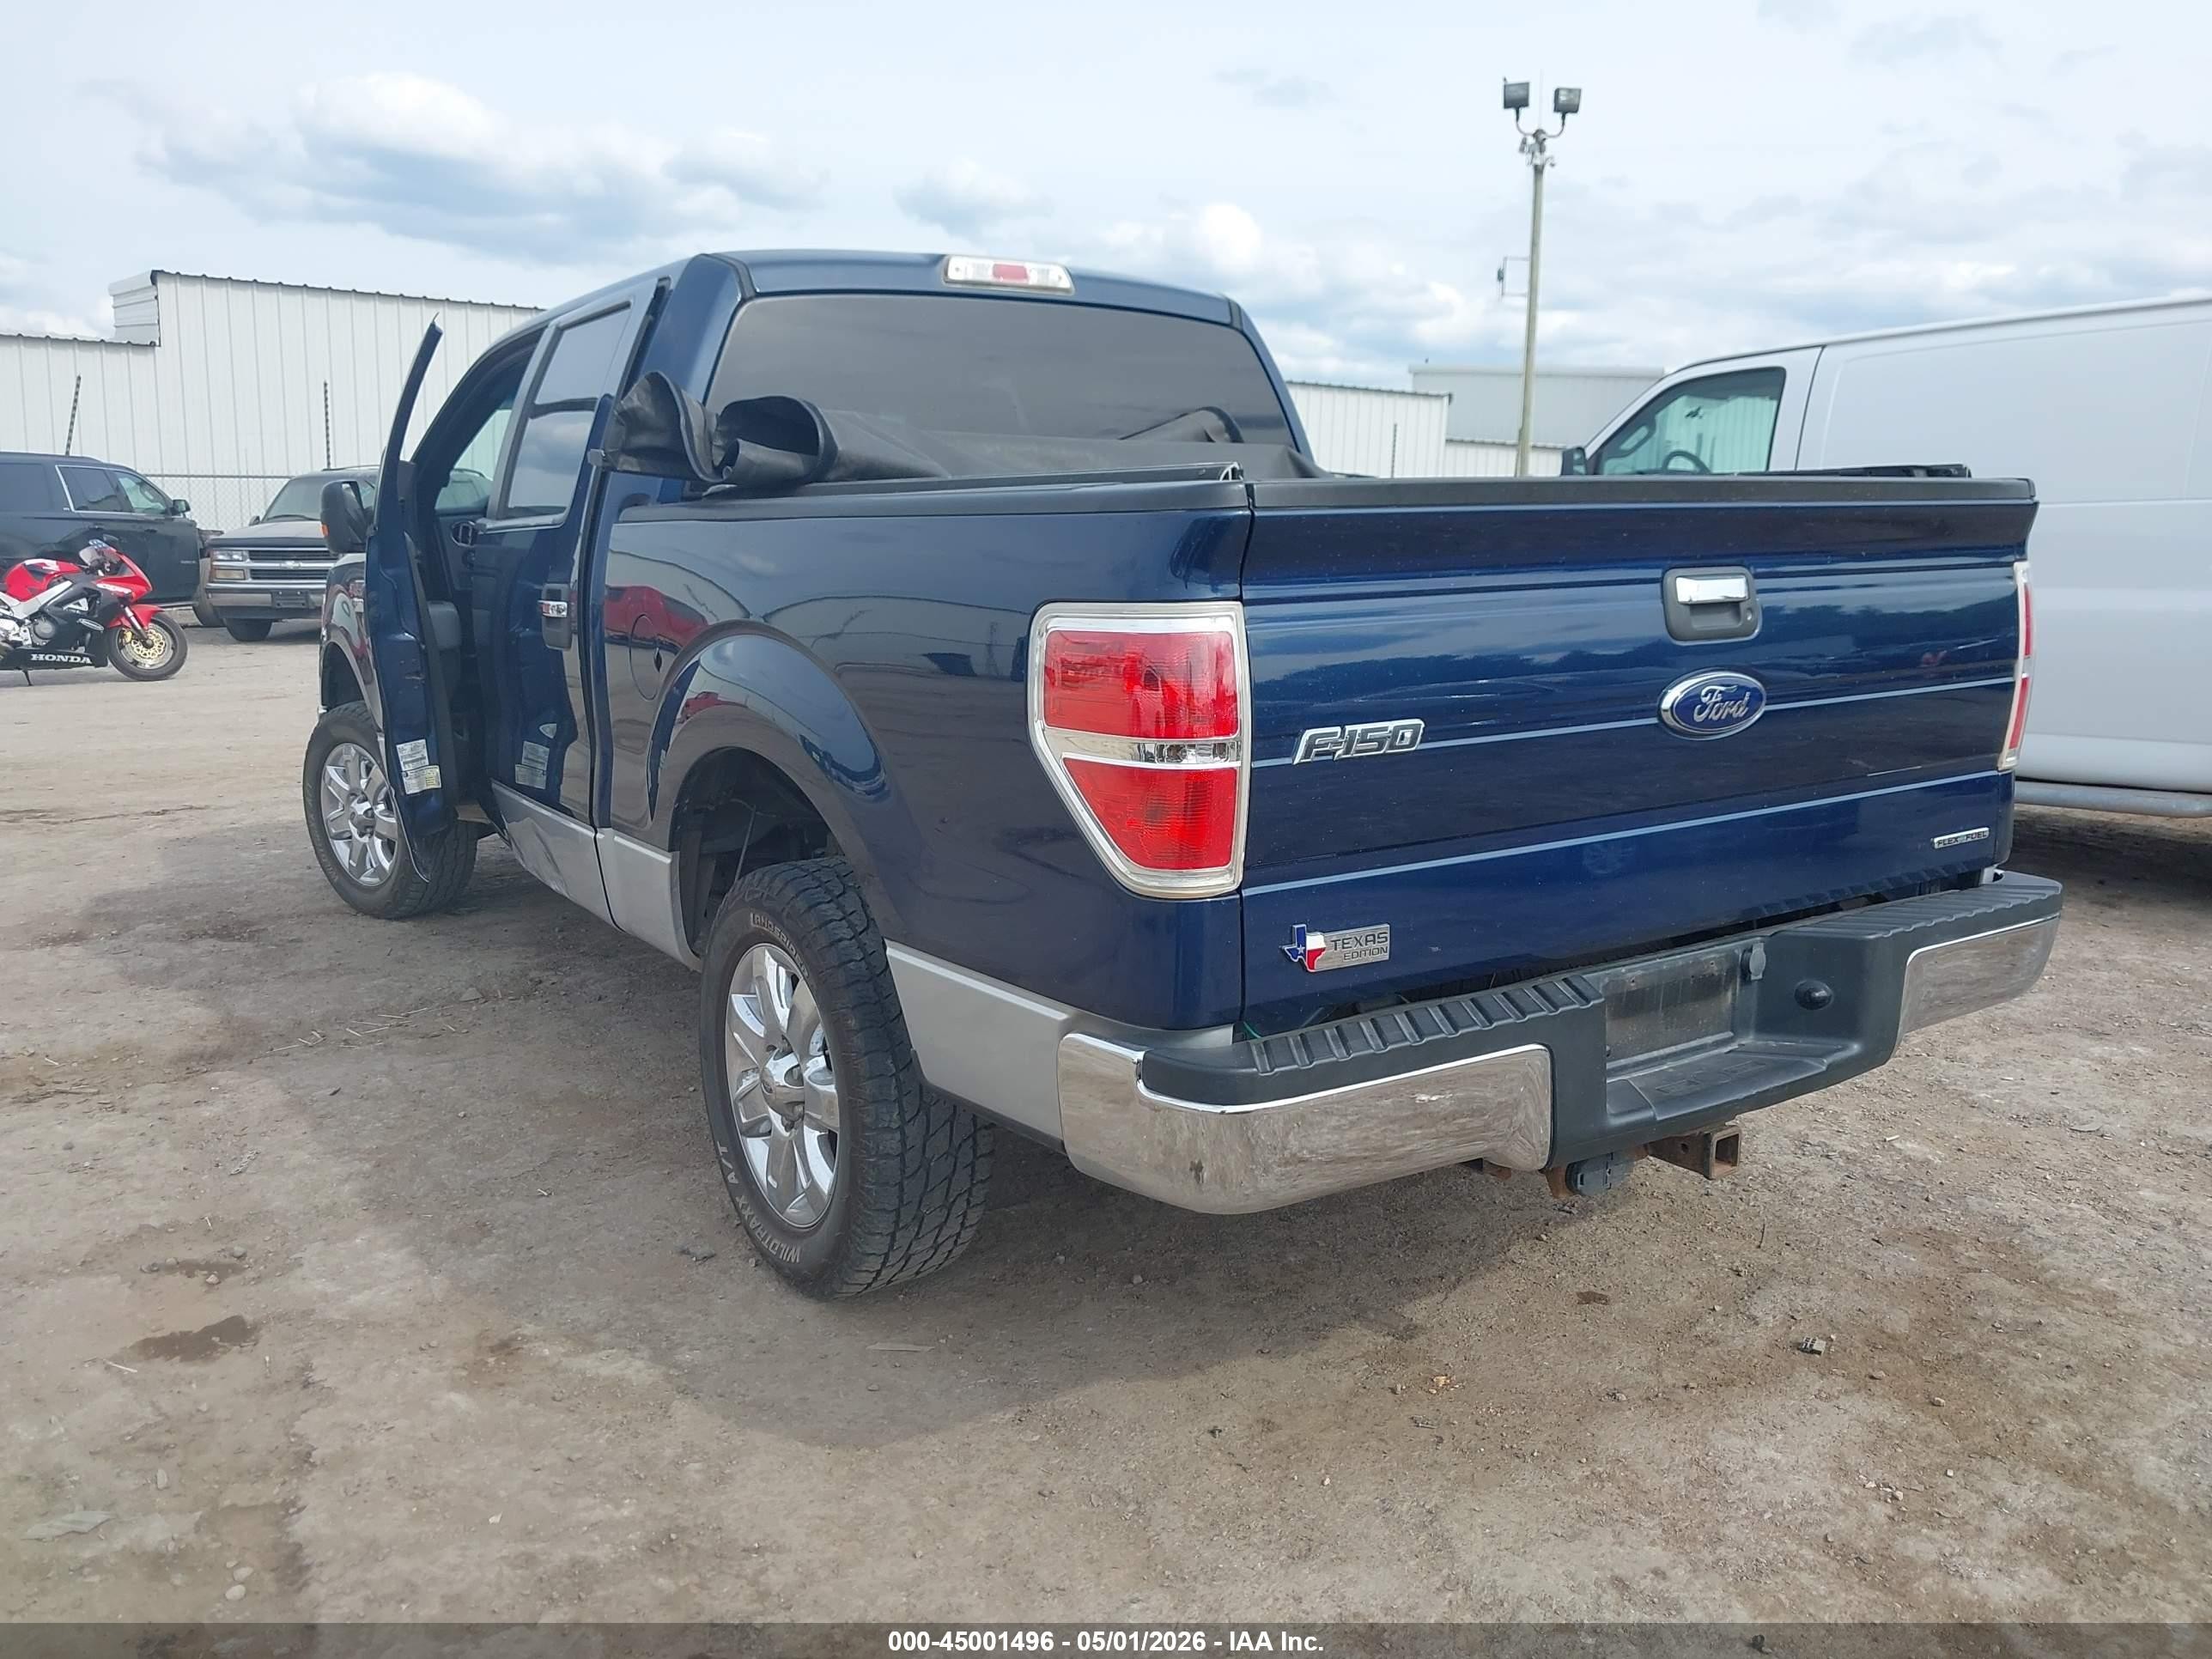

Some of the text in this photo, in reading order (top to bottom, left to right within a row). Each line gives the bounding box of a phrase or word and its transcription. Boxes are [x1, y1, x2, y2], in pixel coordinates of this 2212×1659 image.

[30, 653, 93, 664] HONDA
[1692, 684, 1751, 723] Ford
[1292, 718, 1425, 765] F-150
[1331, 932, 1389, 951] TEXAS
[1343, 946, 1388, 961] EDITION
[716, 1140, 739, 1184] A/T
